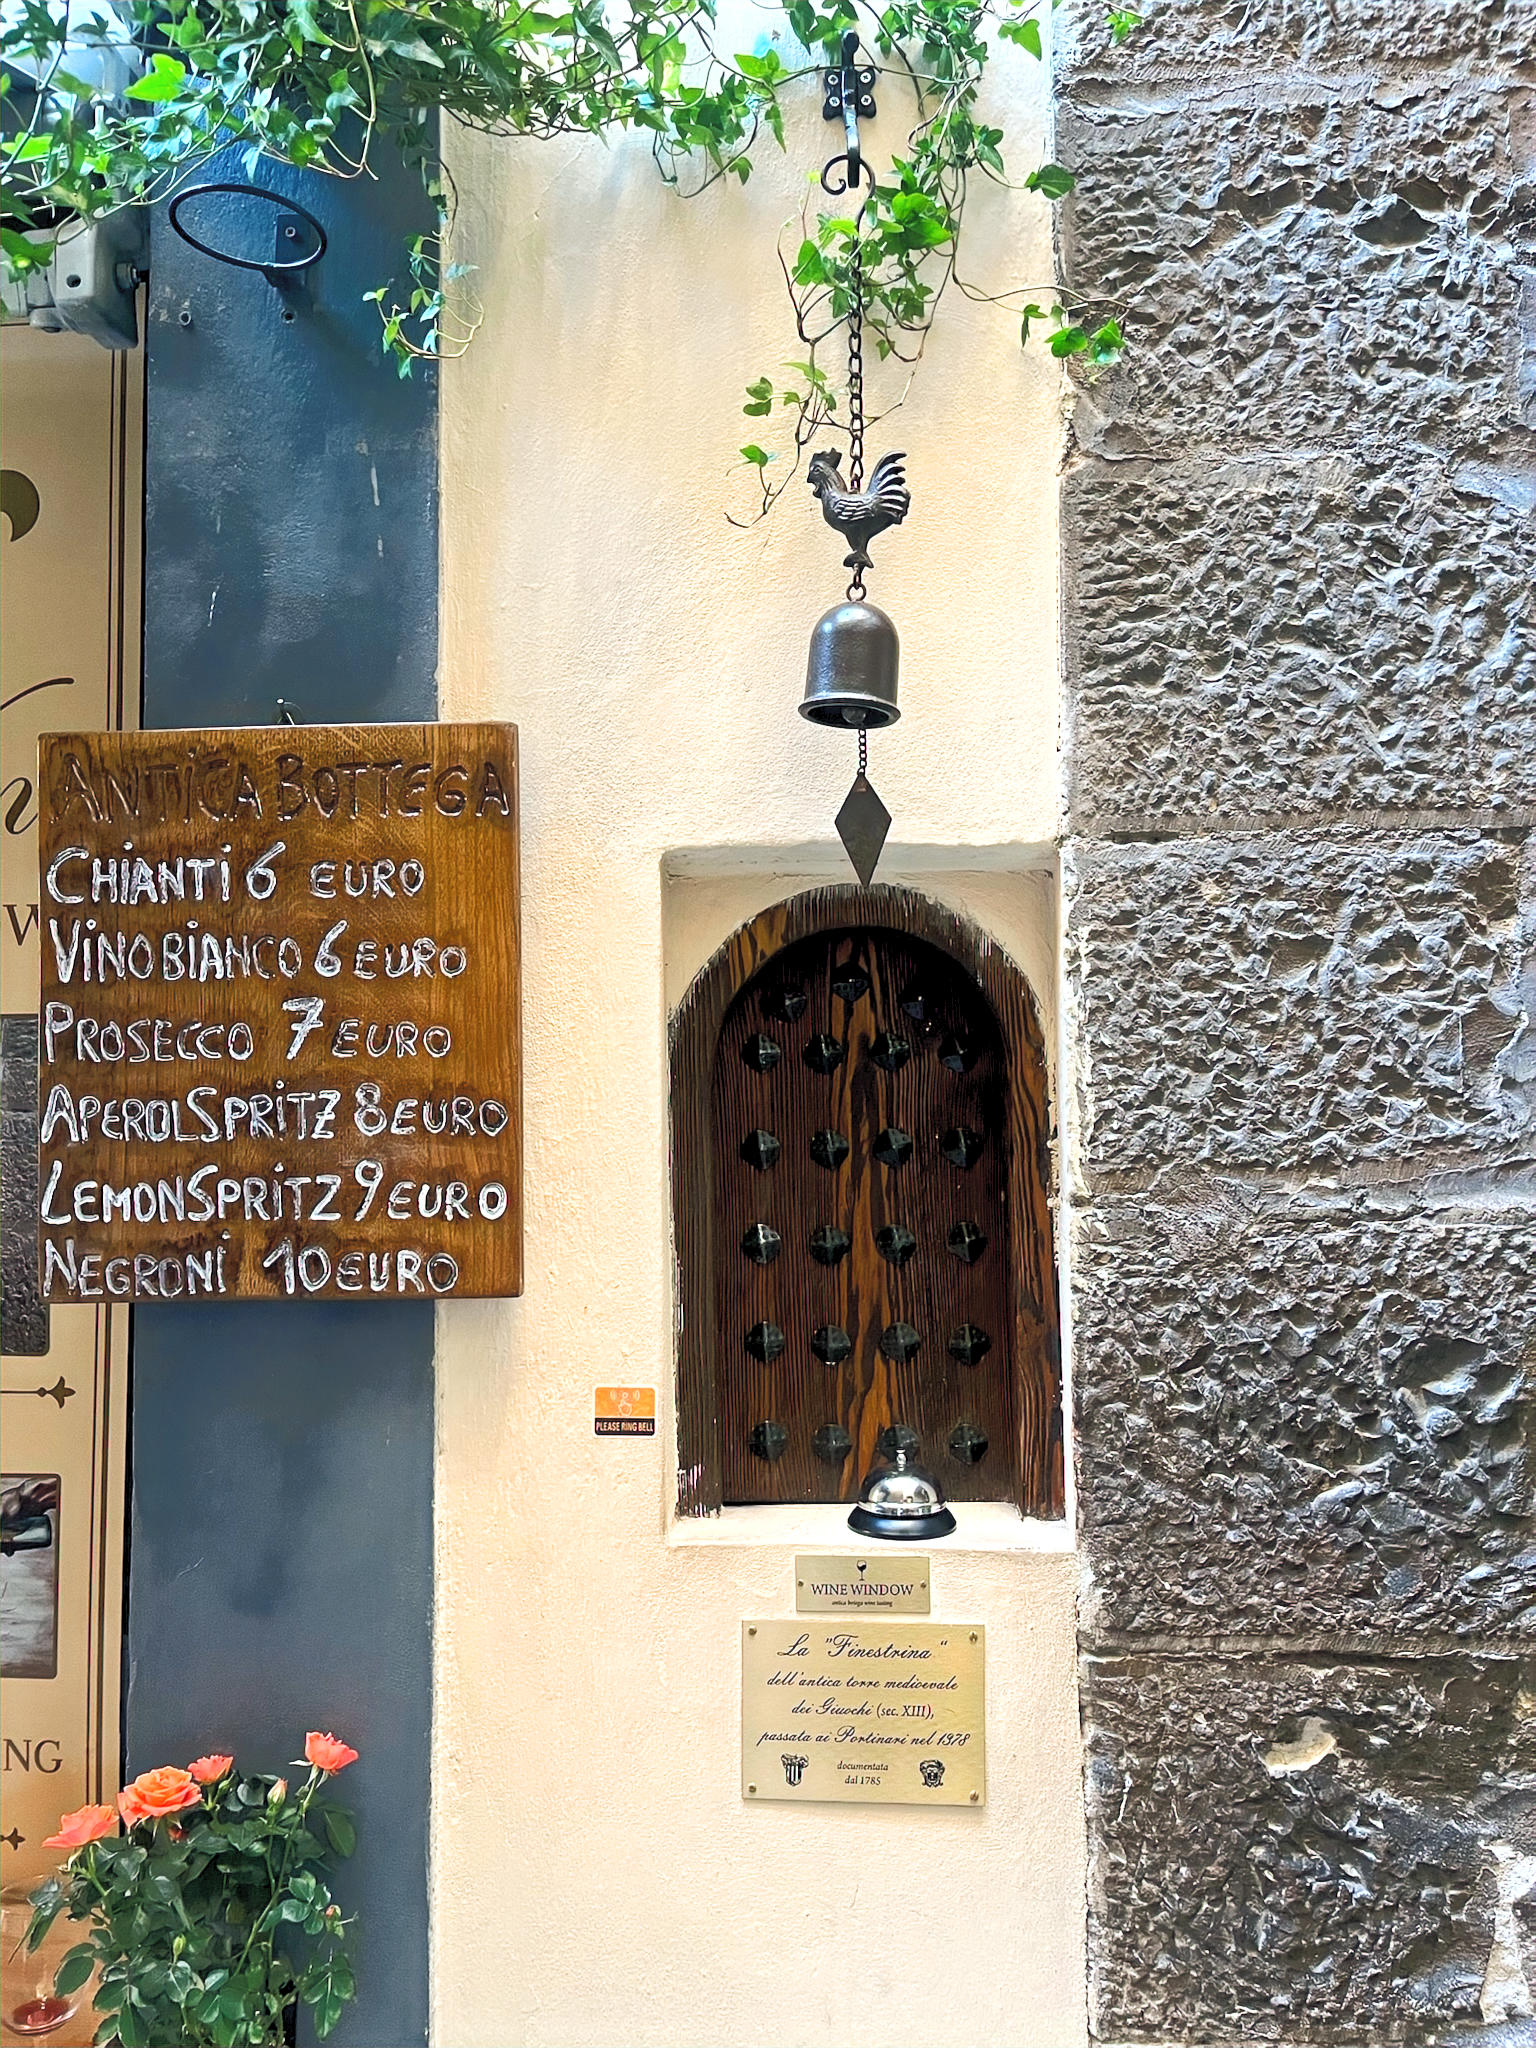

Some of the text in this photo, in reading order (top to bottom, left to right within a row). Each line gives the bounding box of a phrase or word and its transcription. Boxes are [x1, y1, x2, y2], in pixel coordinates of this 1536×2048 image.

[246, 841, 287, 900] 6
[309, 858, 425, 899] EURO
[314, 919, 349, 978] 6
[354, 937, 467, 979] EURO
[44, 996, 452, 1064] PROSECCO 7 EURO
[262, 1237, 333, 1293] 10
[335, 1249, 459, 1292] EURO
[596, 1421, 654, 1432] PLEASE RING BELL
[811, 1583, 914, 1596] WINE WINDOW
[776, 1633, 810, 1657] La
[846, 1675, 880, 1689] torre
[883, 1673, 960, 1691] medioevale
[791, 1699, 814, 1715] dei
[876, 1702, 900, 1719] (sec.
[902, 1704, 935, 1720] XIII),
[756, 1729, 813, 1747] passata
[815, 1732, 833, 1743] ai
[834, 1725, 909, 1745] Portinari
[910, 1730, 937, 1746] nel
[836, 1760, 890, 1772] documentata
[844, 1774, 882, 1787] dal 1785
